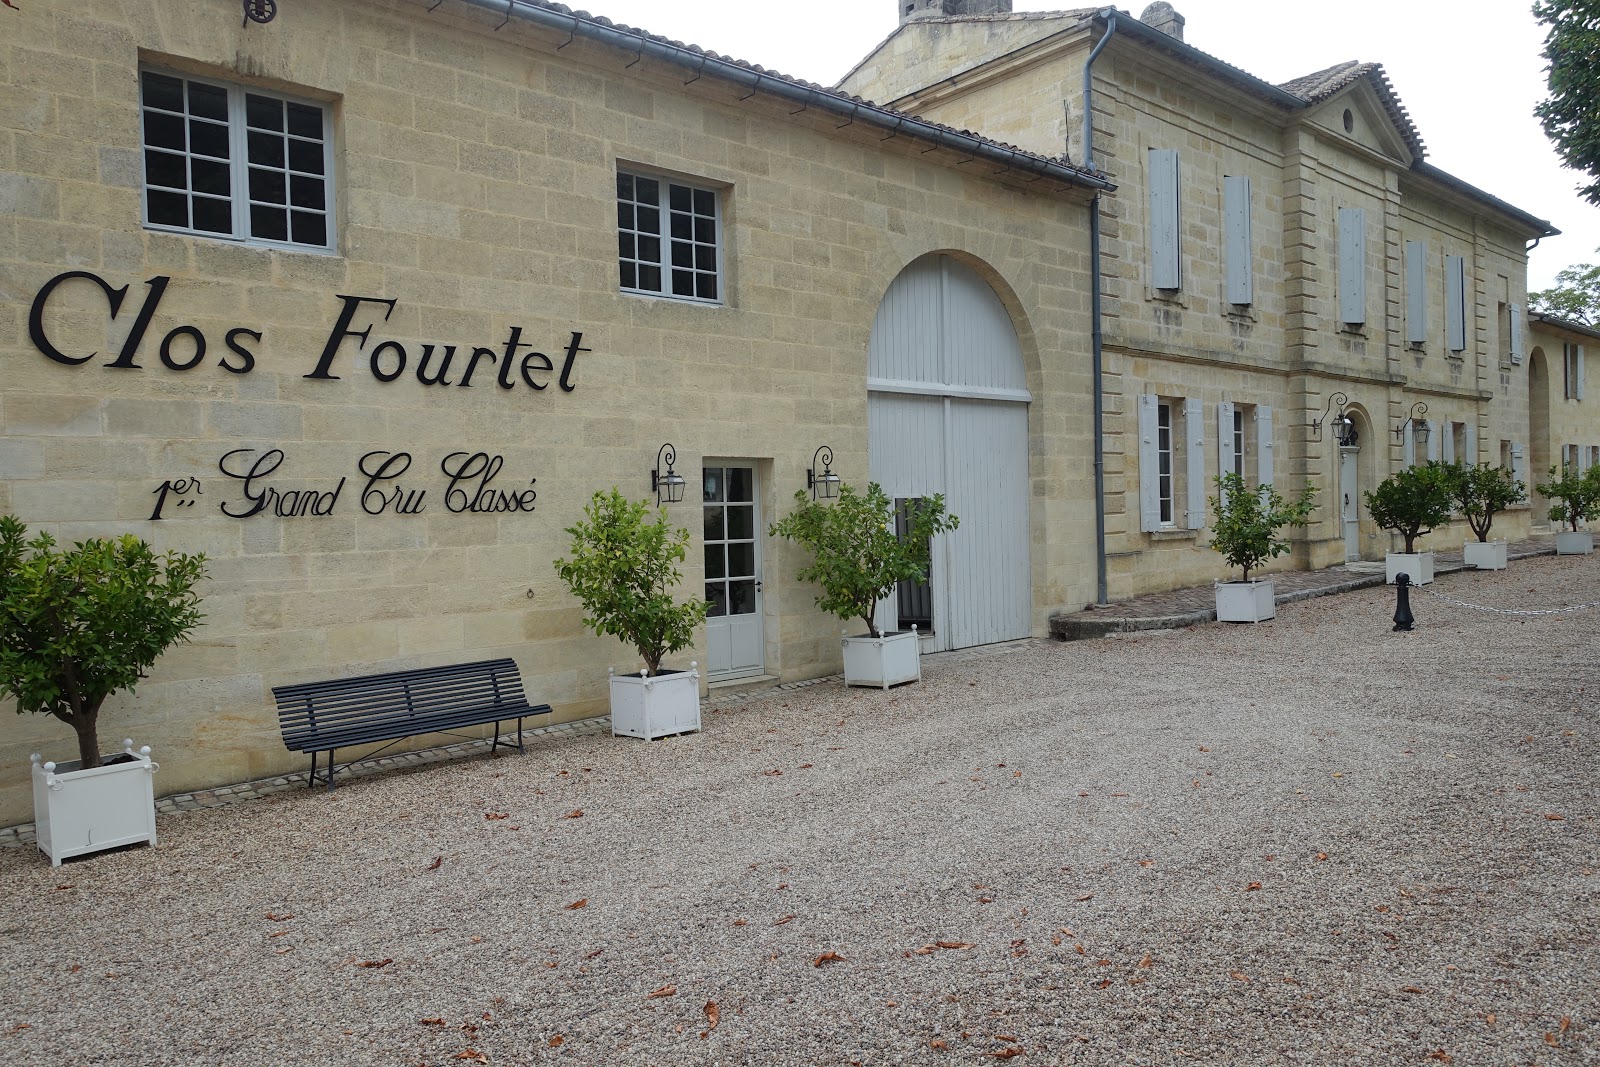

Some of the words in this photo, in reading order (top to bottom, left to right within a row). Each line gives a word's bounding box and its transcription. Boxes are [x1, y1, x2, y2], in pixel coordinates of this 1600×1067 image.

[29, 271, 263, 374] Clos
[303, 294, 592, 392] Fourtet
[219, 449, 346, 519] Grand
[358, 450, 427, 516] Cru
[440, 451, 537, 514] Classé
